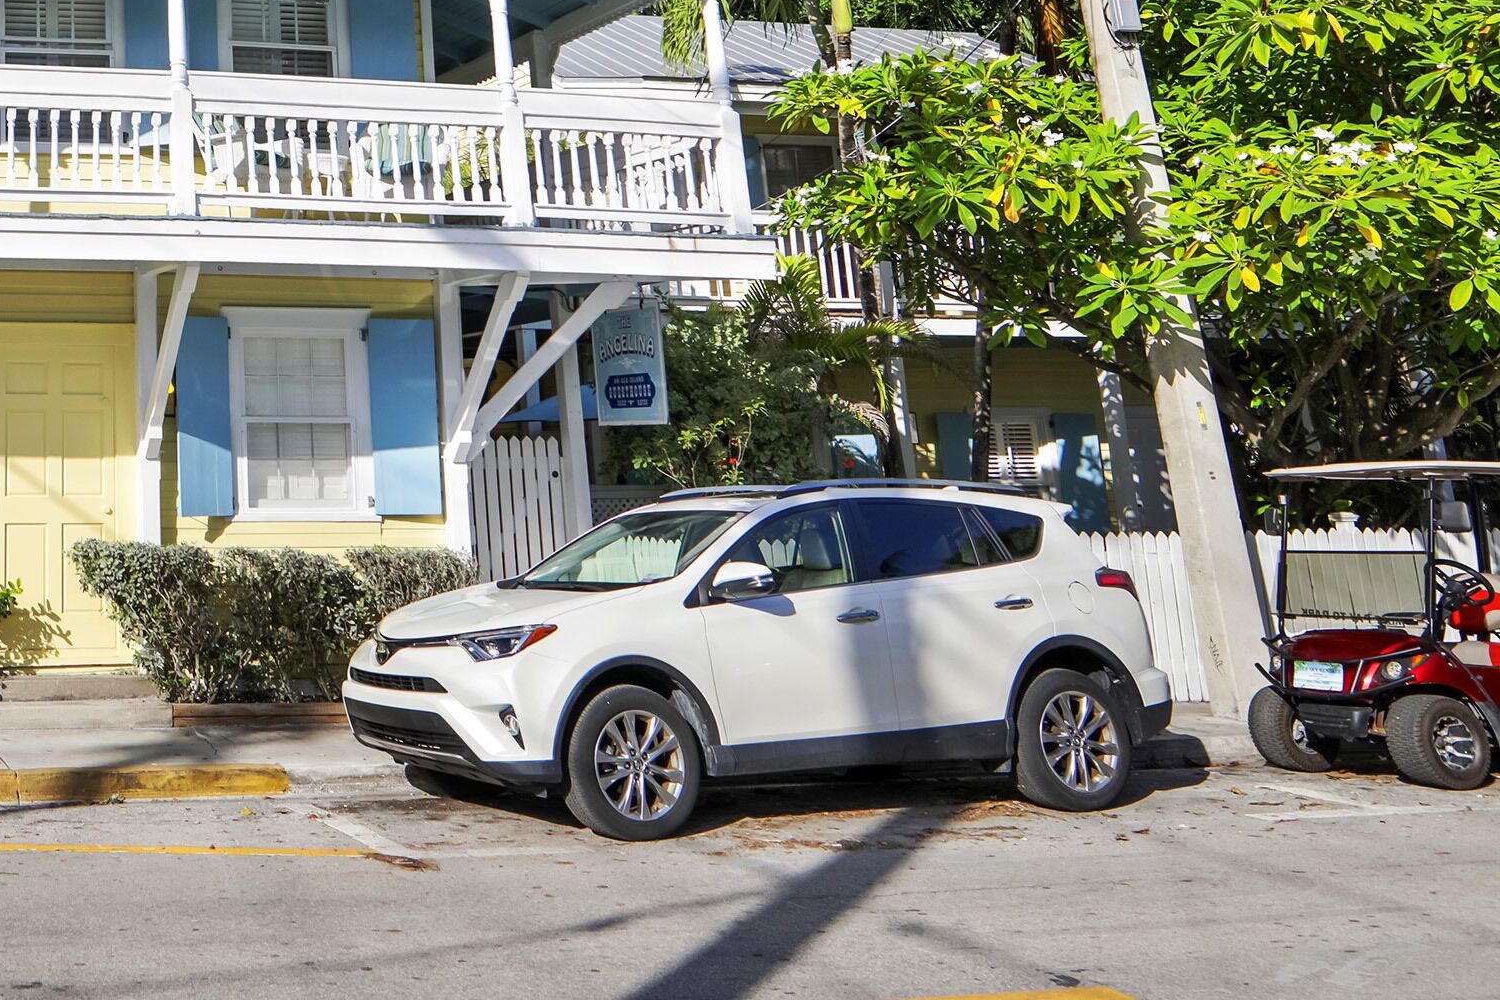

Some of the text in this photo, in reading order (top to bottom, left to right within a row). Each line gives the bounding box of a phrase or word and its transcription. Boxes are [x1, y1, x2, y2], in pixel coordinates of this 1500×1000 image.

[617, 316, 631, 328] THE
[600, 333, 654, 363] ANGELINA
[609, 384, 651, 399] GUESTHOUSE
